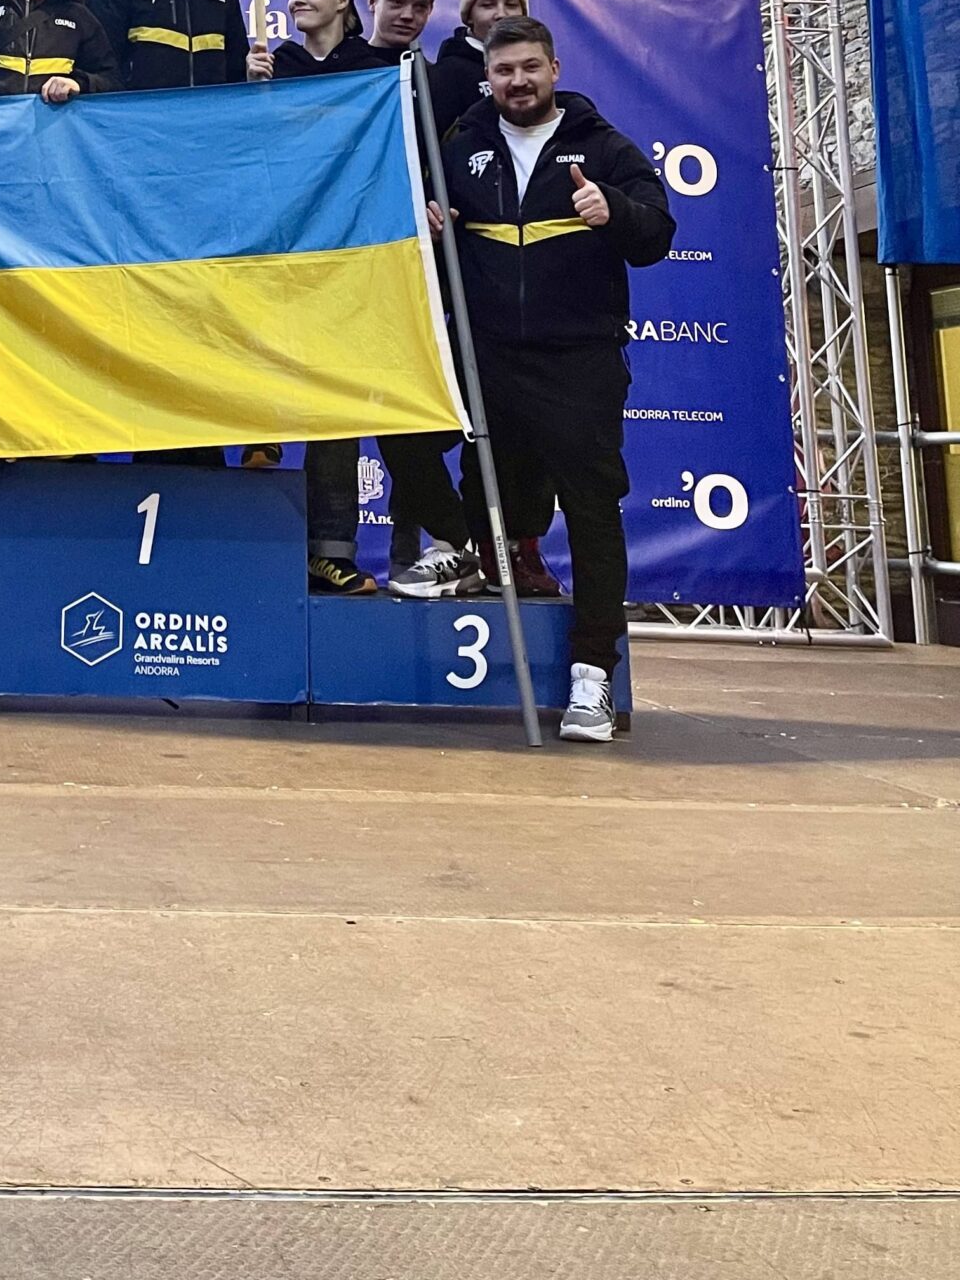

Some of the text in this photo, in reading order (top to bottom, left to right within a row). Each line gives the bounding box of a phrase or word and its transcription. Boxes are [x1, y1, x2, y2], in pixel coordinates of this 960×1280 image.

[556, 155, 585, 164] COLMAR
[665, 249, 712, 262] ELECOM
[624, 320, 729, 344] RABANC
[623, 409, 724, 422] NDORRA TELECOM
[651, 496, 691, 509] ordino
[137, 493, 160, 565] 1
[135, 612, 228, 632] ORDINO
[134, 632, 228, 653] ARCALÍS
[445, 614, 490, 689] 3
[134, 653, 220, 666] Grandvalira Resorts
[134, 665, 180, 677] ANDORRA
